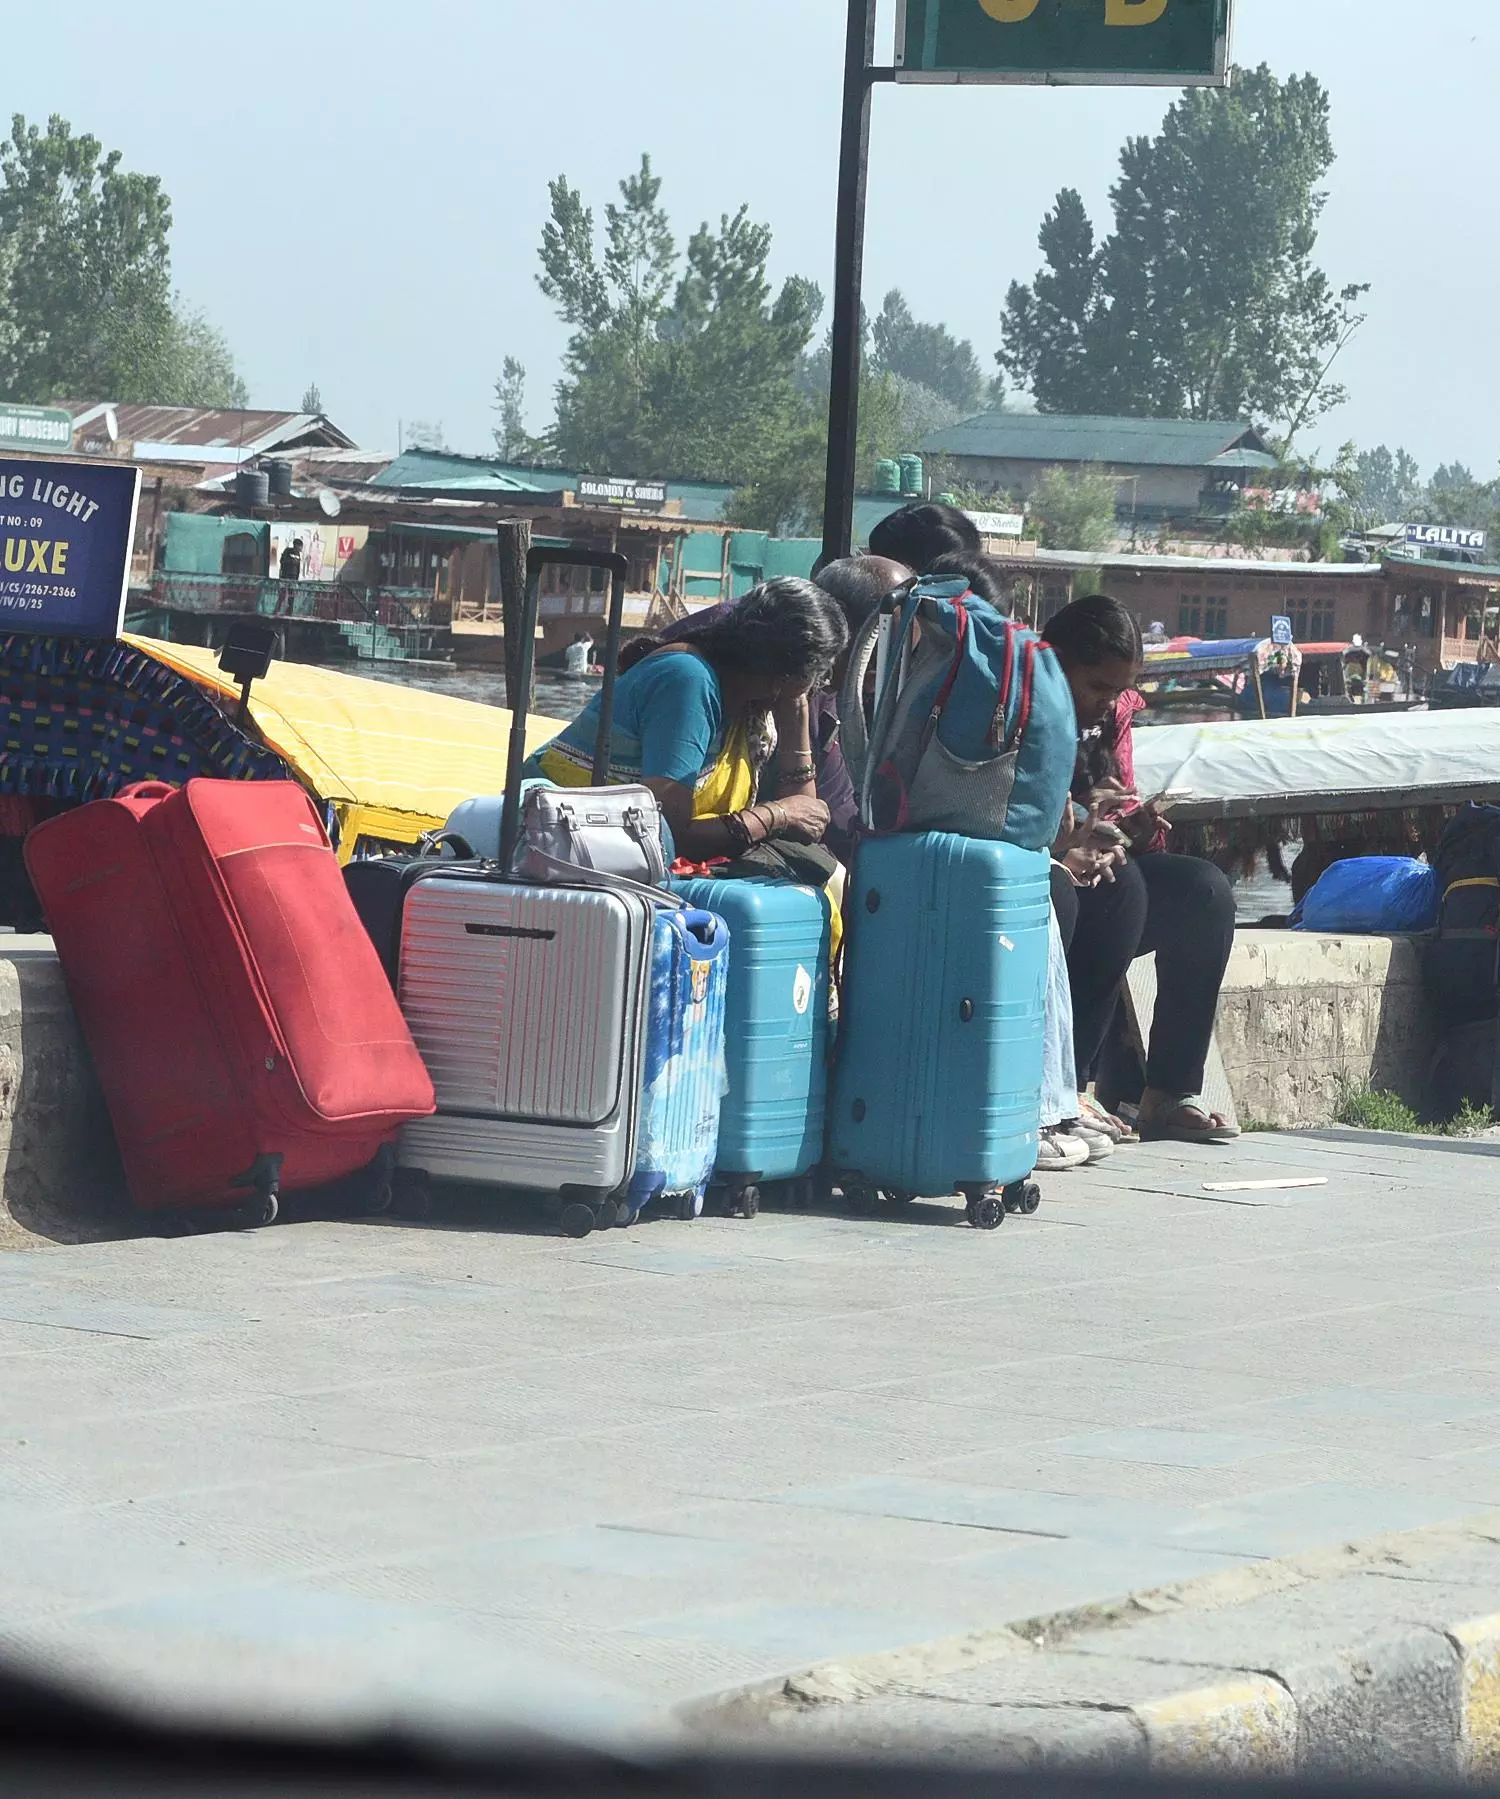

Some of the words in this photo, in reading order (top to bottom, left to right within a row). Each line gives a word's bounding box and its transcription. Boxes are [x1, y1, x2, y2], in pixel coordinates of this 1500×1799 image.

[32, 478, 99, 522] LIGHT
[581, 482, 624, 497] SOLOMON
[626, 486, 634, 498] &
[7, 516, 21, 526] NO
[30, 517, 43, 528] 09
[1416, 526, 1484, 546] LALITA
[0, 538, 69, 575] UXE
